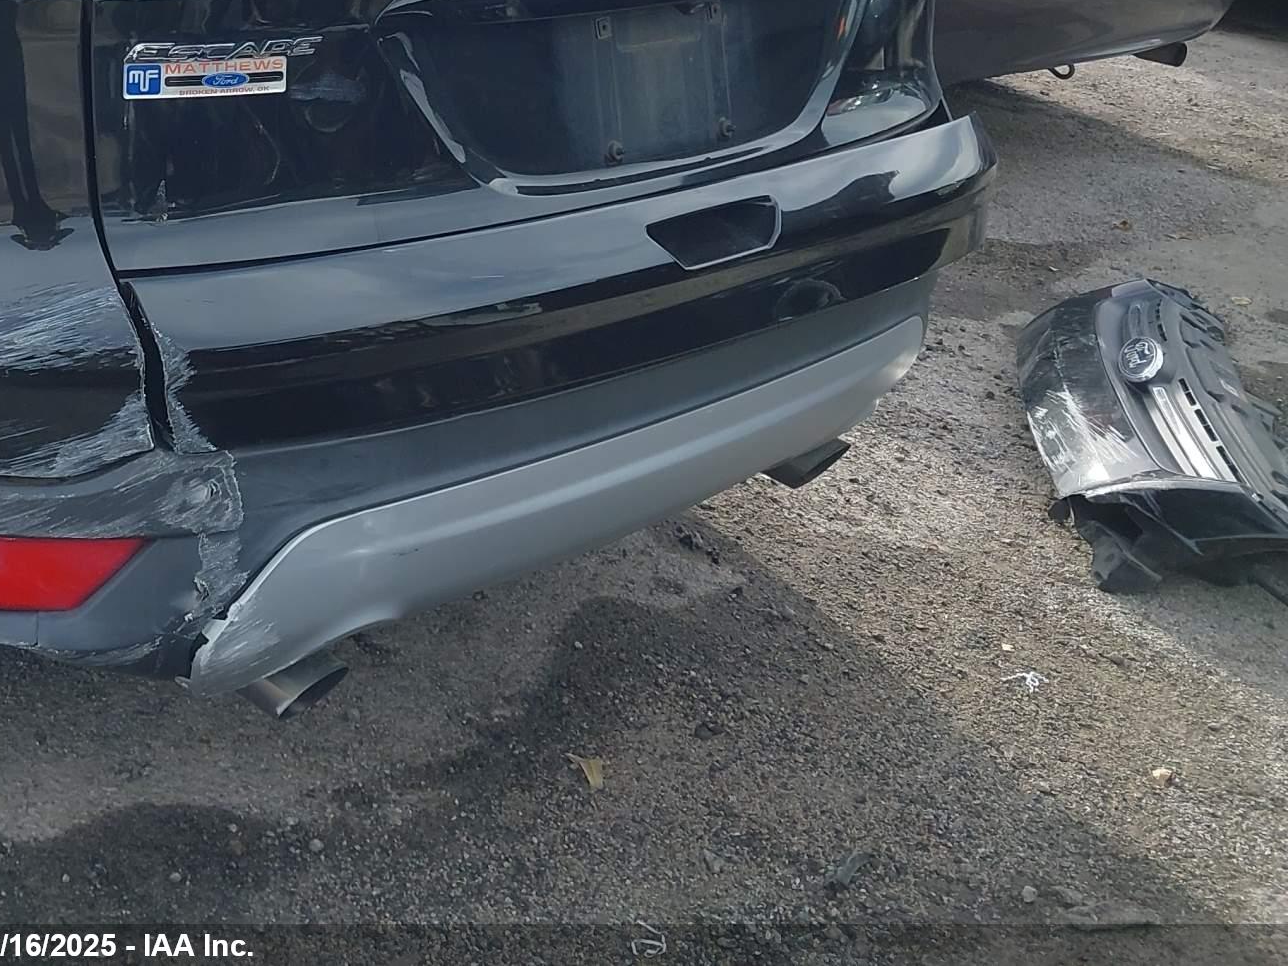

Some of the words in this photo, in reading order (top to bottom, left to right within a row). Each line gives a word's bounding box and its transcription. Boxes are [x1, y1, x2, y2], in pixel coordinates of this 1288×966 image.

[124, 36, 324, 62] ESCAPE
[165, 59, 285, 75] MATTHEWS
[212, 75, 239, 86] Ford
[179, 88, 221, 96] BROKEN
